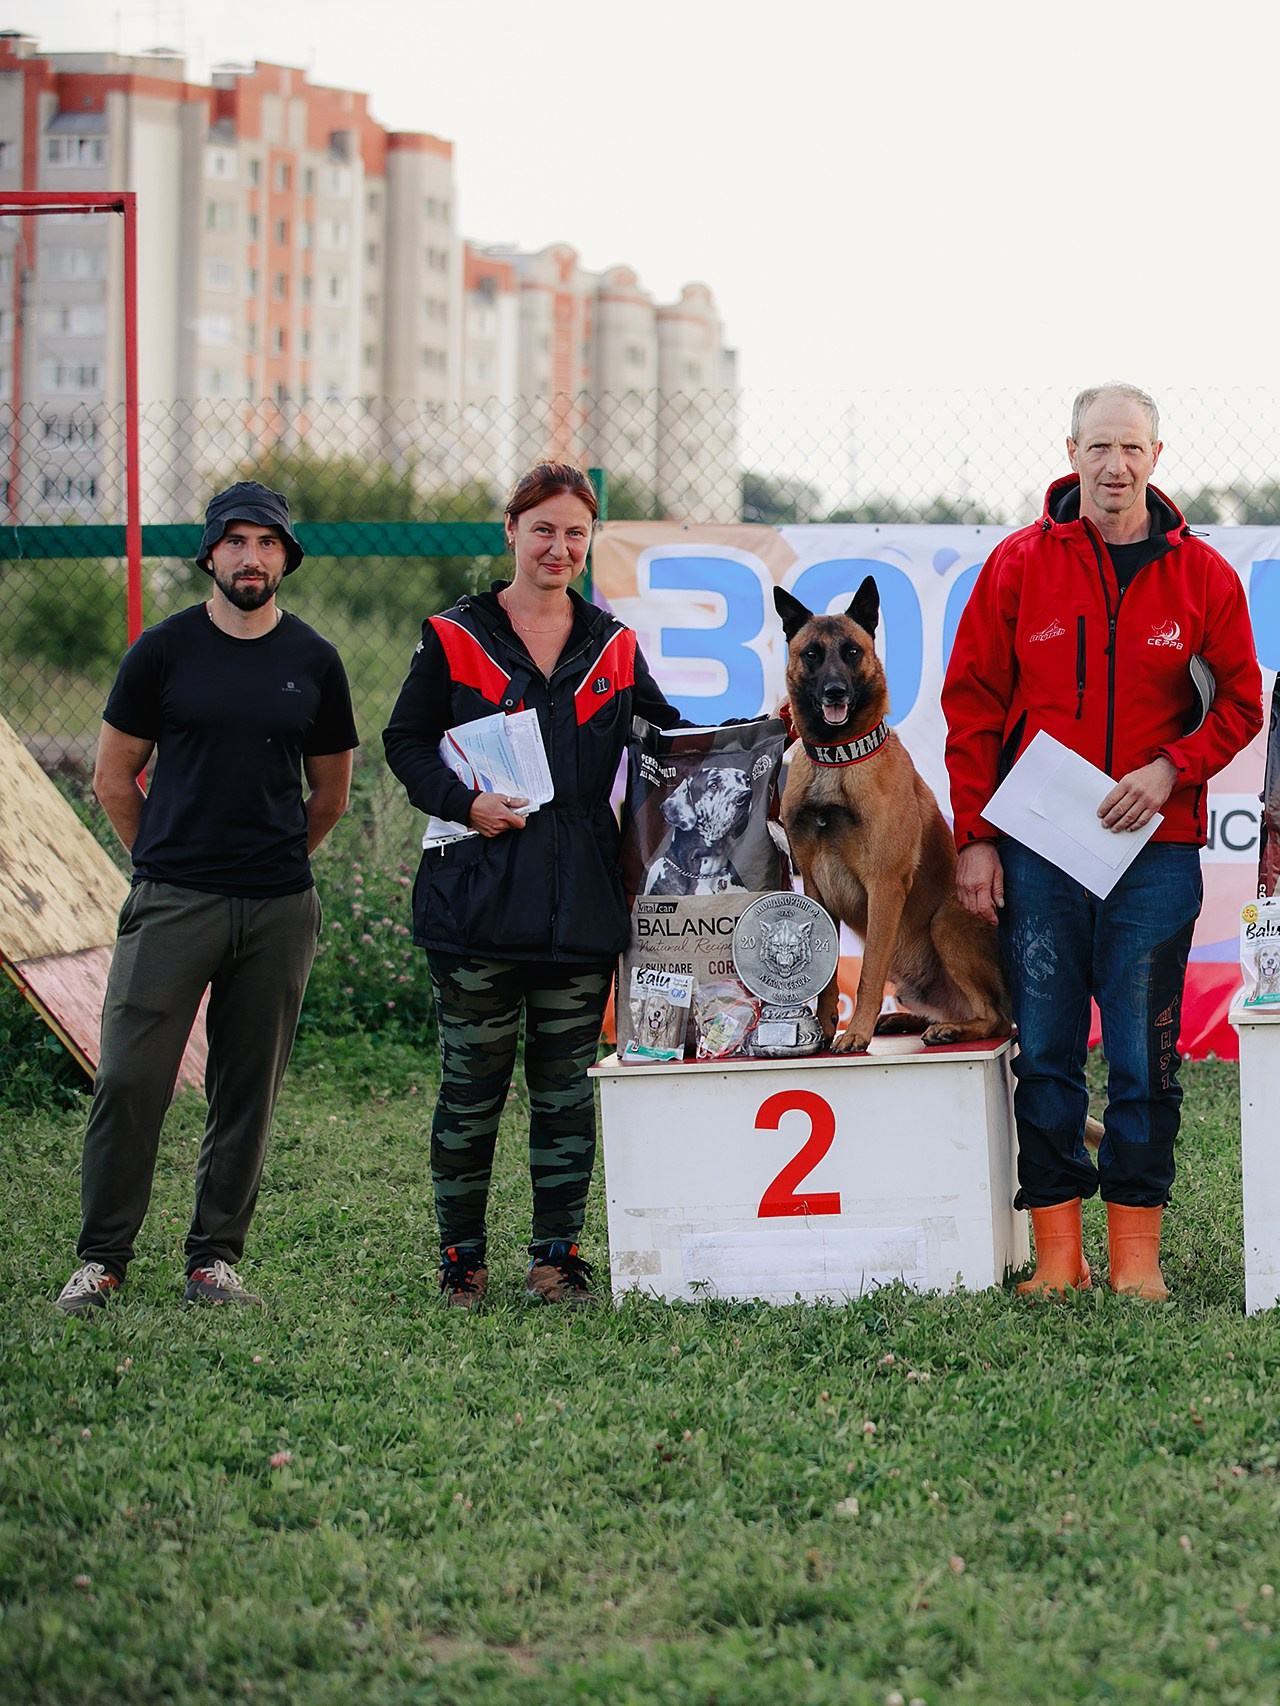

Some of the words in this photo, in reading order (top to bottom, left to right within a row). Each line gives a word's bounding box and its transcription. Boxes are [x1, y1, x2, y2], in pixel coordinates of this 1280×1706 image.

[638, 916, 740, 937] BALANC
[638, 937, 689, 953] Natural
[741, 936, 756, 950] 20
[815, 939, 830, 953] 24
[668, 963, 693, 974] CARE
[754, 1089, 842, 1218] 2
